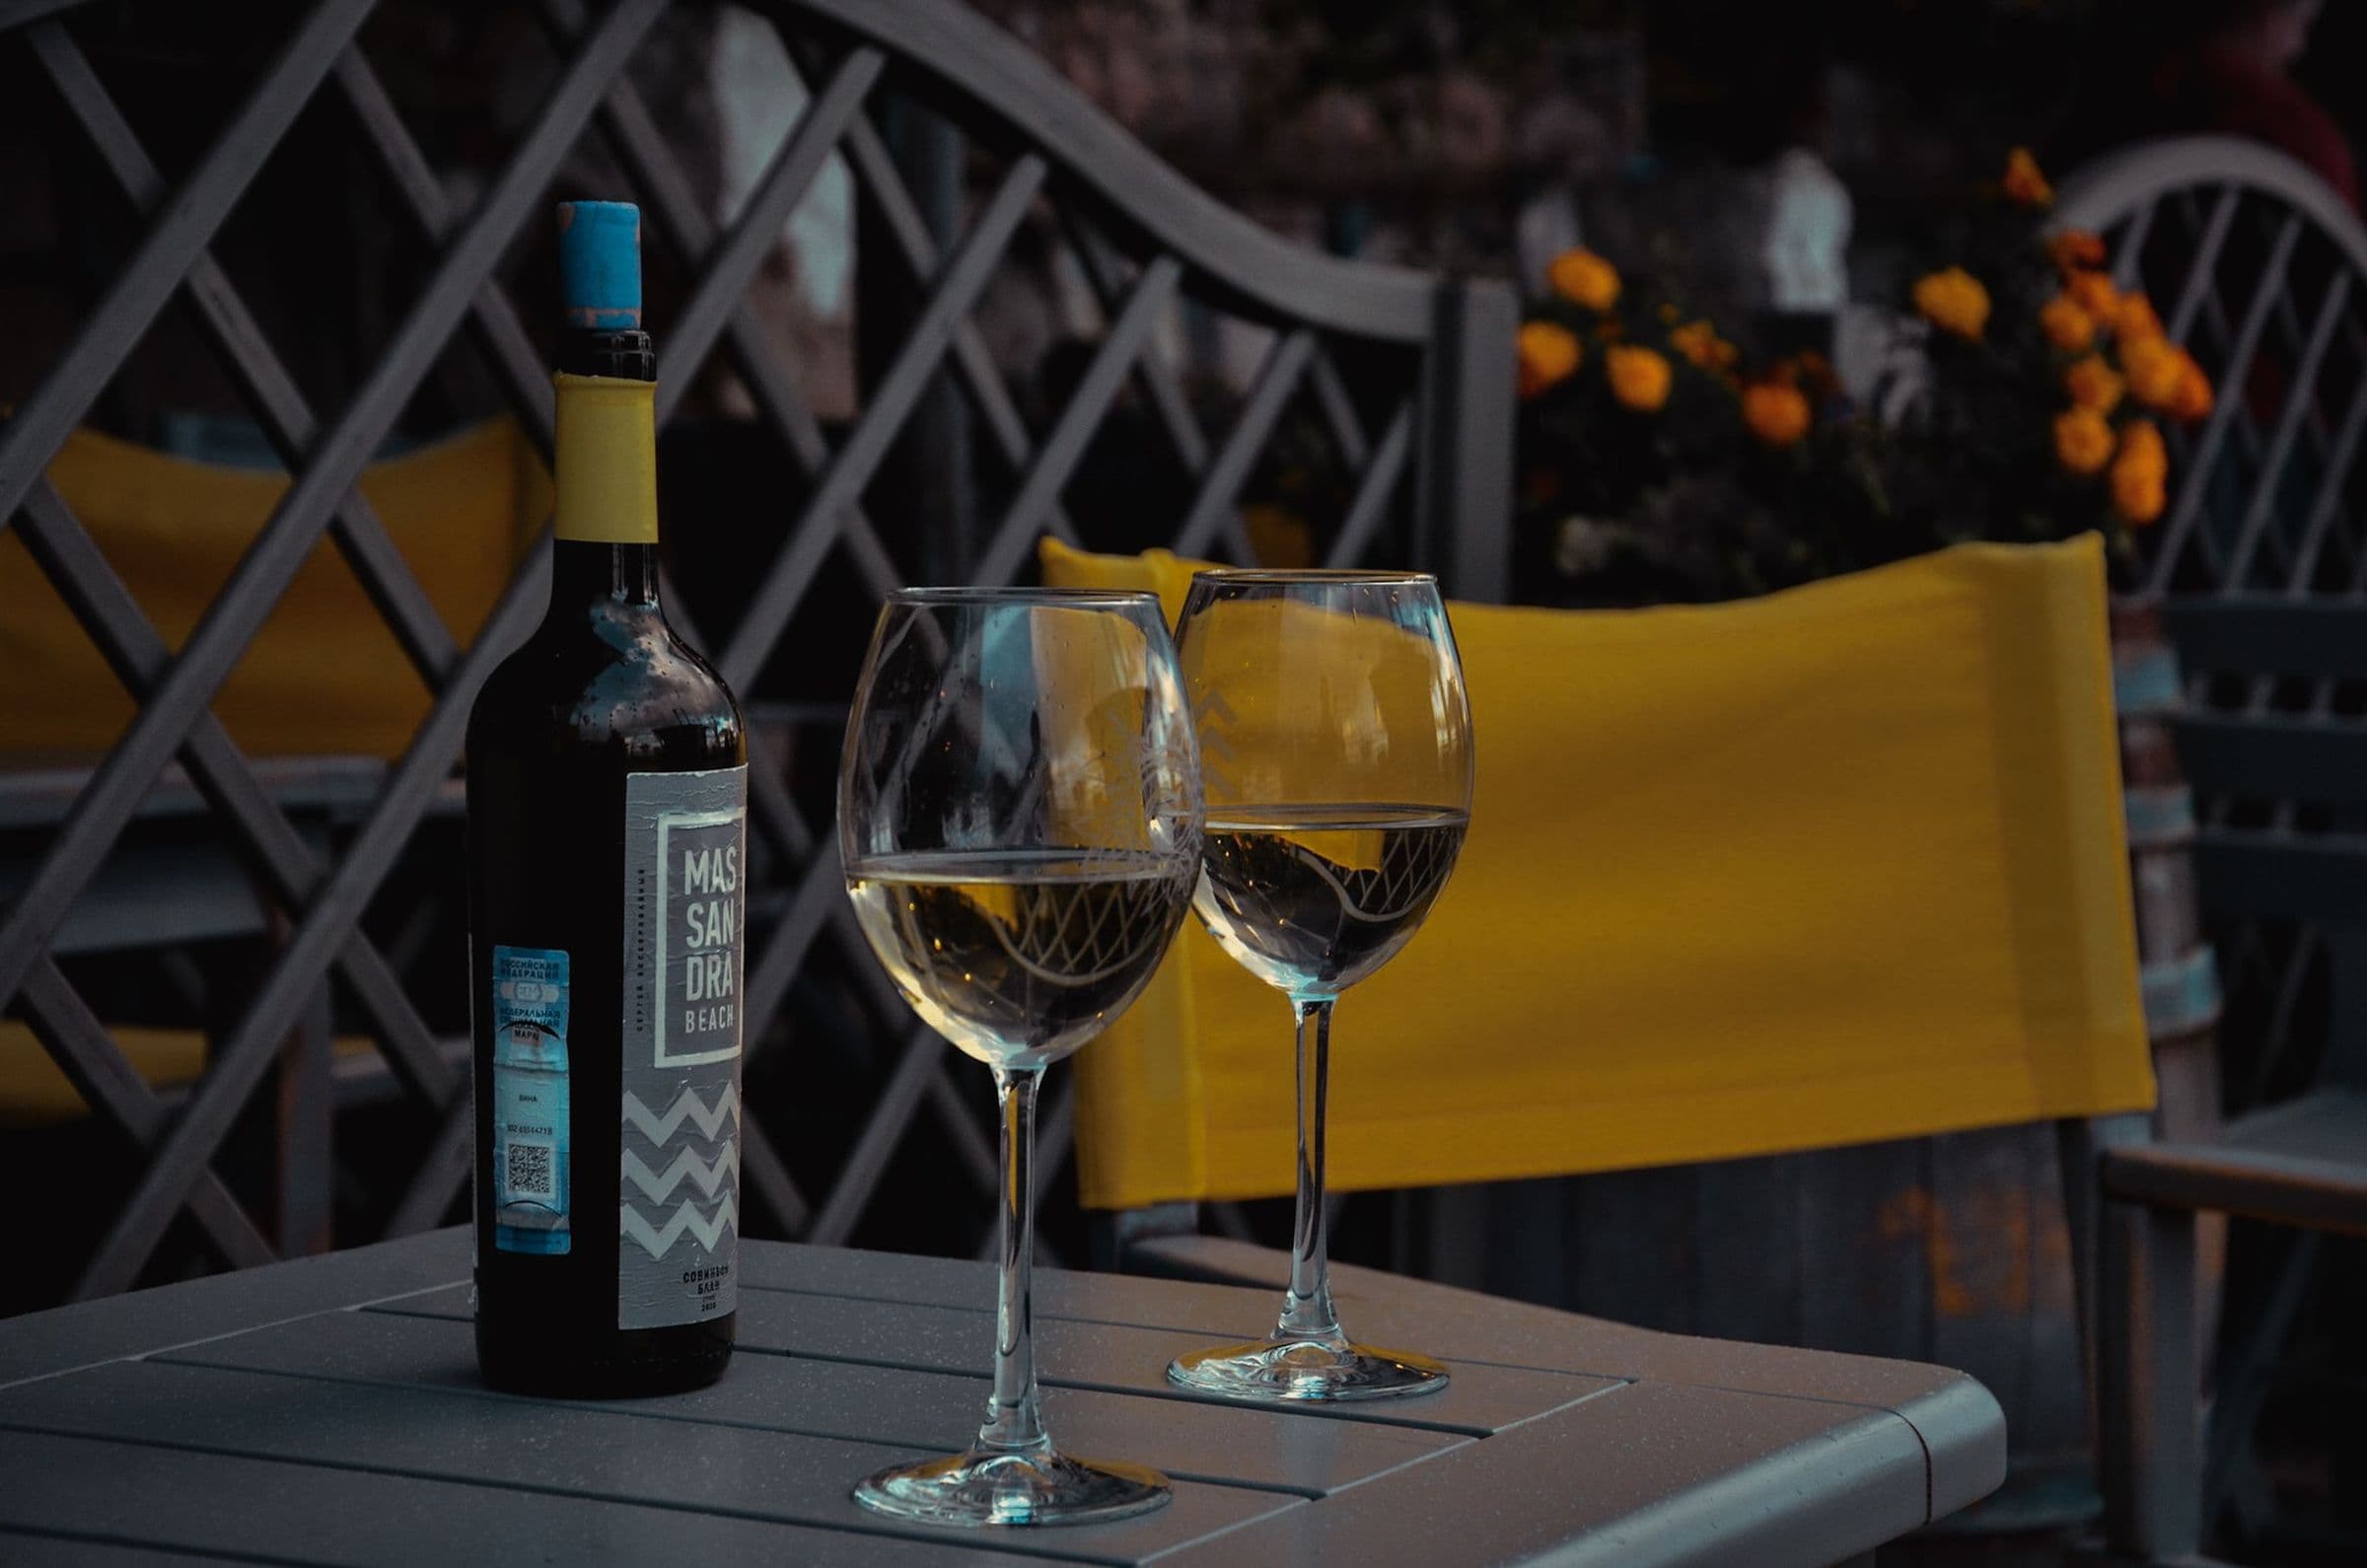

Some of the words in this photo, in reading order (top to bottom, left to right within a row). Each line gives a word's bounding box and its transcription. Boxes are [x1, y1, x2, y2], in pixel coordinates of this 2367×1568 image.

[684, 845, 737, 895] MAS
[686, 898, 735, 949] SAN
[685, 952, 734, 1002] DRA
[685, 1004, 734, 1034] BEACH
